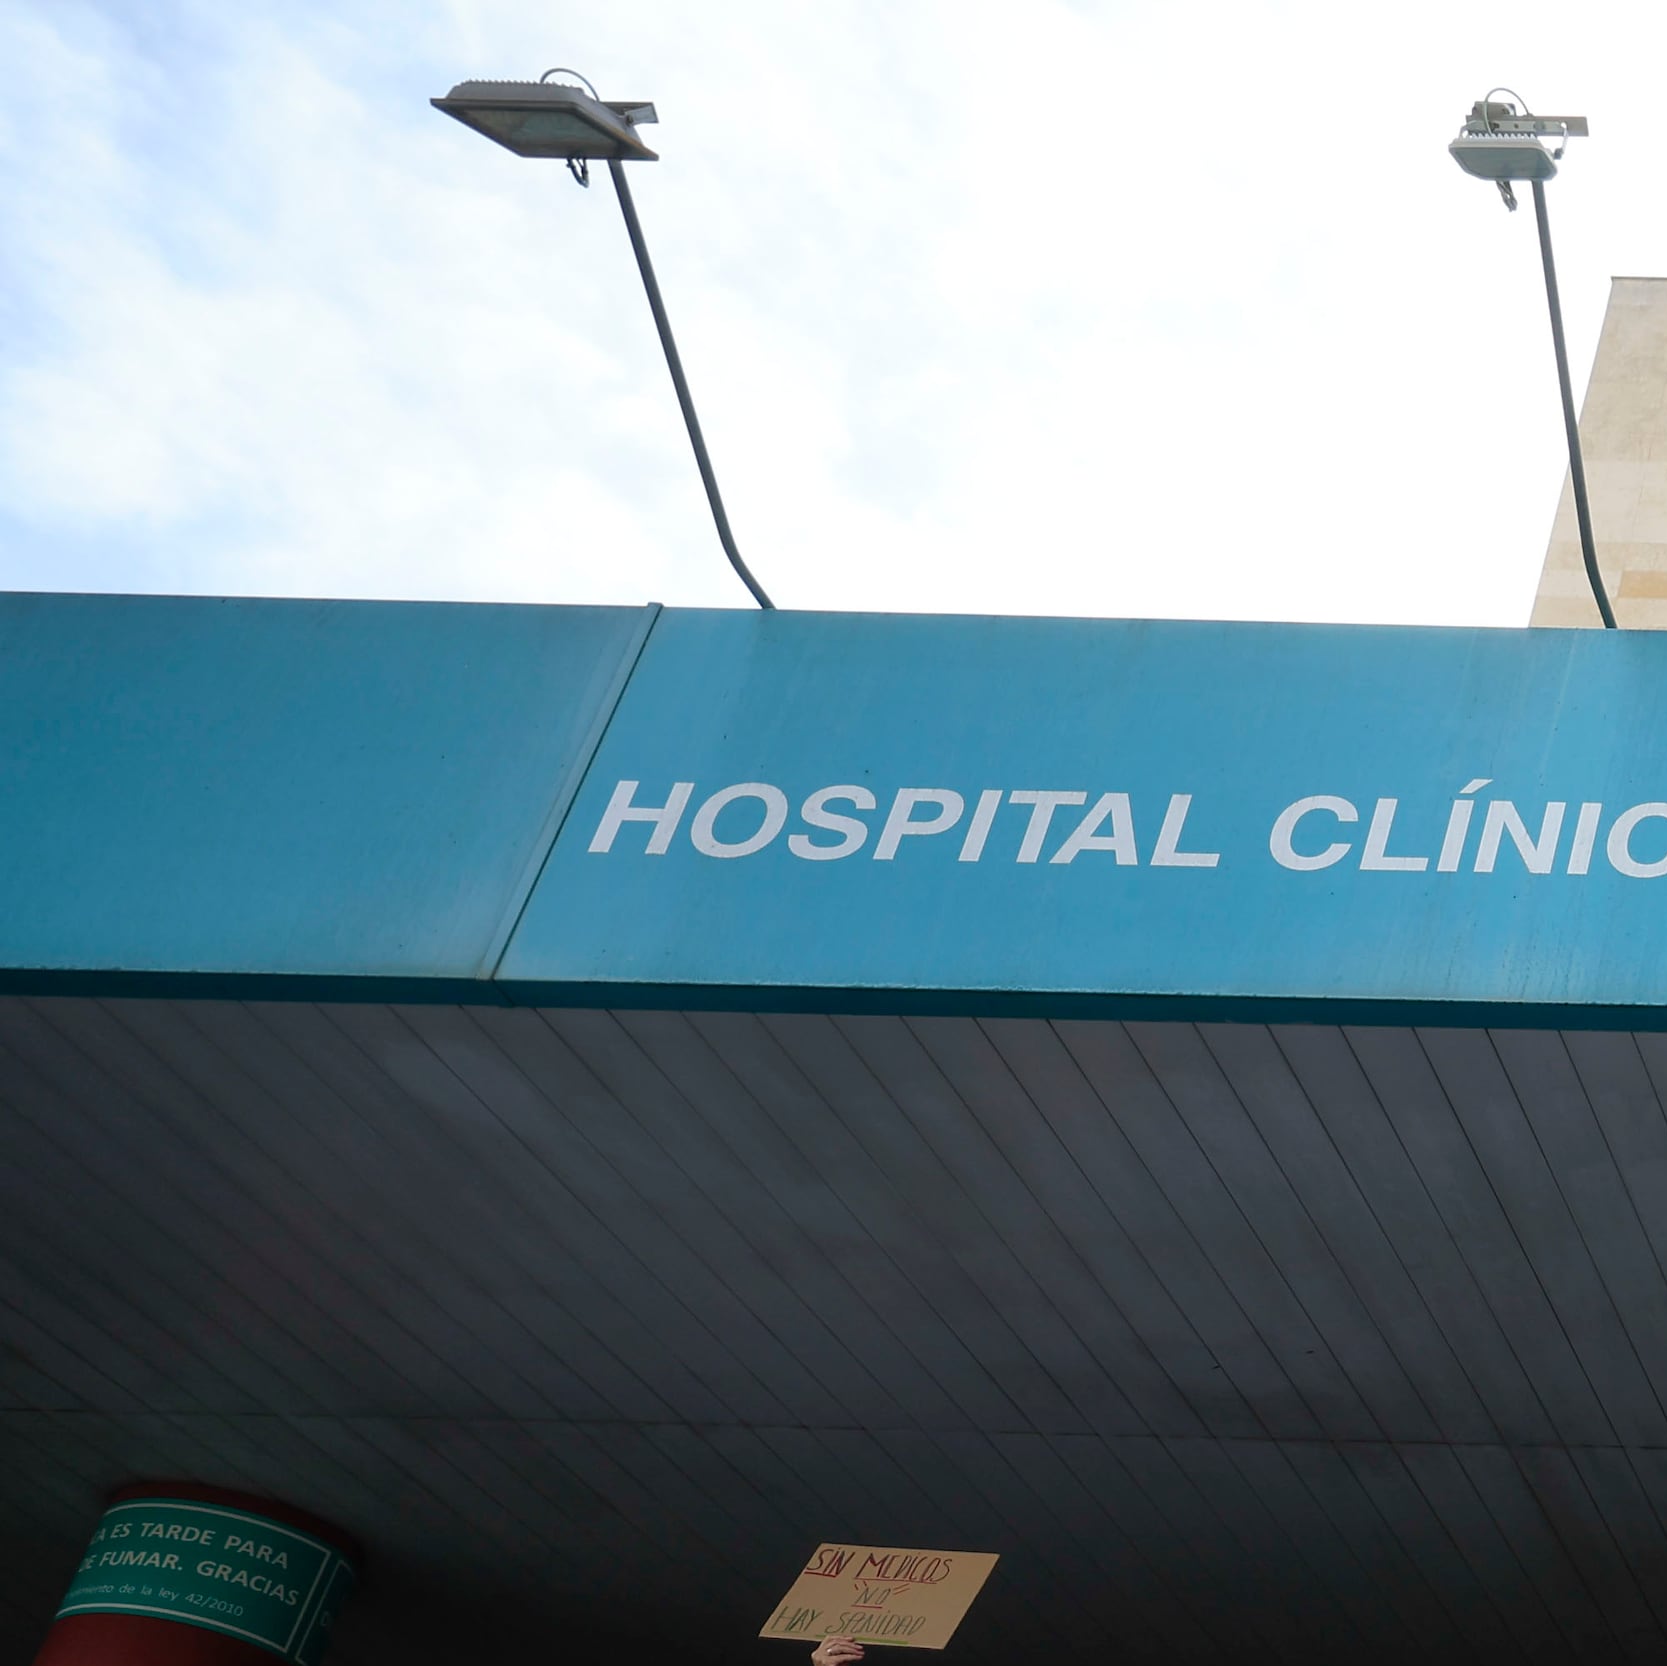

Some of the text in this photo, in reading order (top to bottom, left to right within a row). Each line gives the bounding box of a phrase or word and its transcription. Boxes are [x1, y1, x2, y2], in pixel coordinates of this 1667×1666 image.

[588, 780, 1220, 867] HOSPITAL
[110, 1522, 132, 1539] ES
[140, 1522, 216, 1546] TARDE
[224, 1534, 289, 1570] PARA
[806, 1547, 855, 1575] SIN
[99, 1550, 299, 1607] FUMAR. GRACIAS
[119, 1583, 136, 1595] de
[158, 1586, 179, 1601] ley
[185, 1592, 244, 1618] 42/2010
[771, 1606, 823, 1632] HAY
